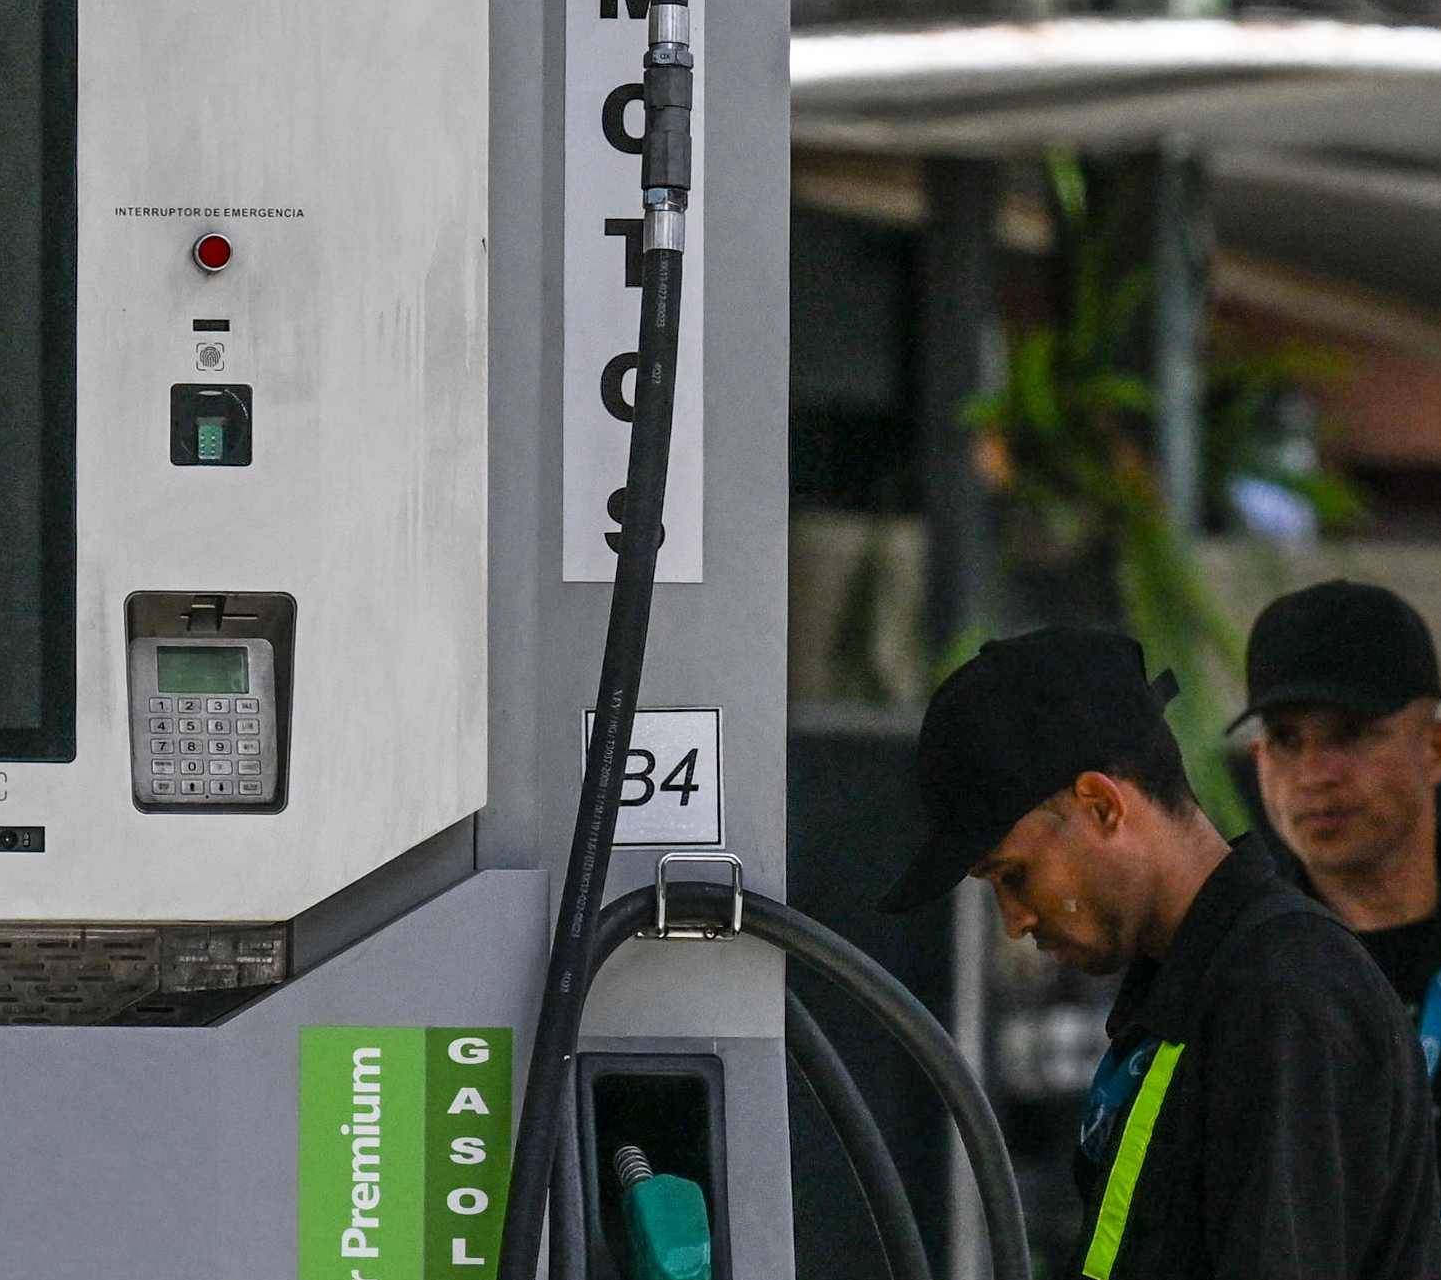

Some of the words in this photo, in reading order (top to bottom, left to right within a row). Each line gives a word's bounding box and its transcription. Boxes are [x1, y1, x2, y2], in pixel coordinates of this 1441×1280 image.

[115, 207, 201, 217] INTERRUPTOR
[204, 207, 220, 218] DE
[223, 207, 305, 218] EMERGENCIA
[158, 701, 165, 711] 1
[185, 701, 193, 711] 2
[214, 701, 223, 711] 3
[157, 721, 166, 731] 4
[186, 721, 195, 731] 5
[214, 721, 224, 731] 6
[159, 742, 167, 752] 7
[187, 742, 196, 752] 8
[215, 742, 225, 752] 9
[188, 762, 197, 772] 0
[619, 748, 700, 807] B4
[340, 1047, 382, 1258] Premium
